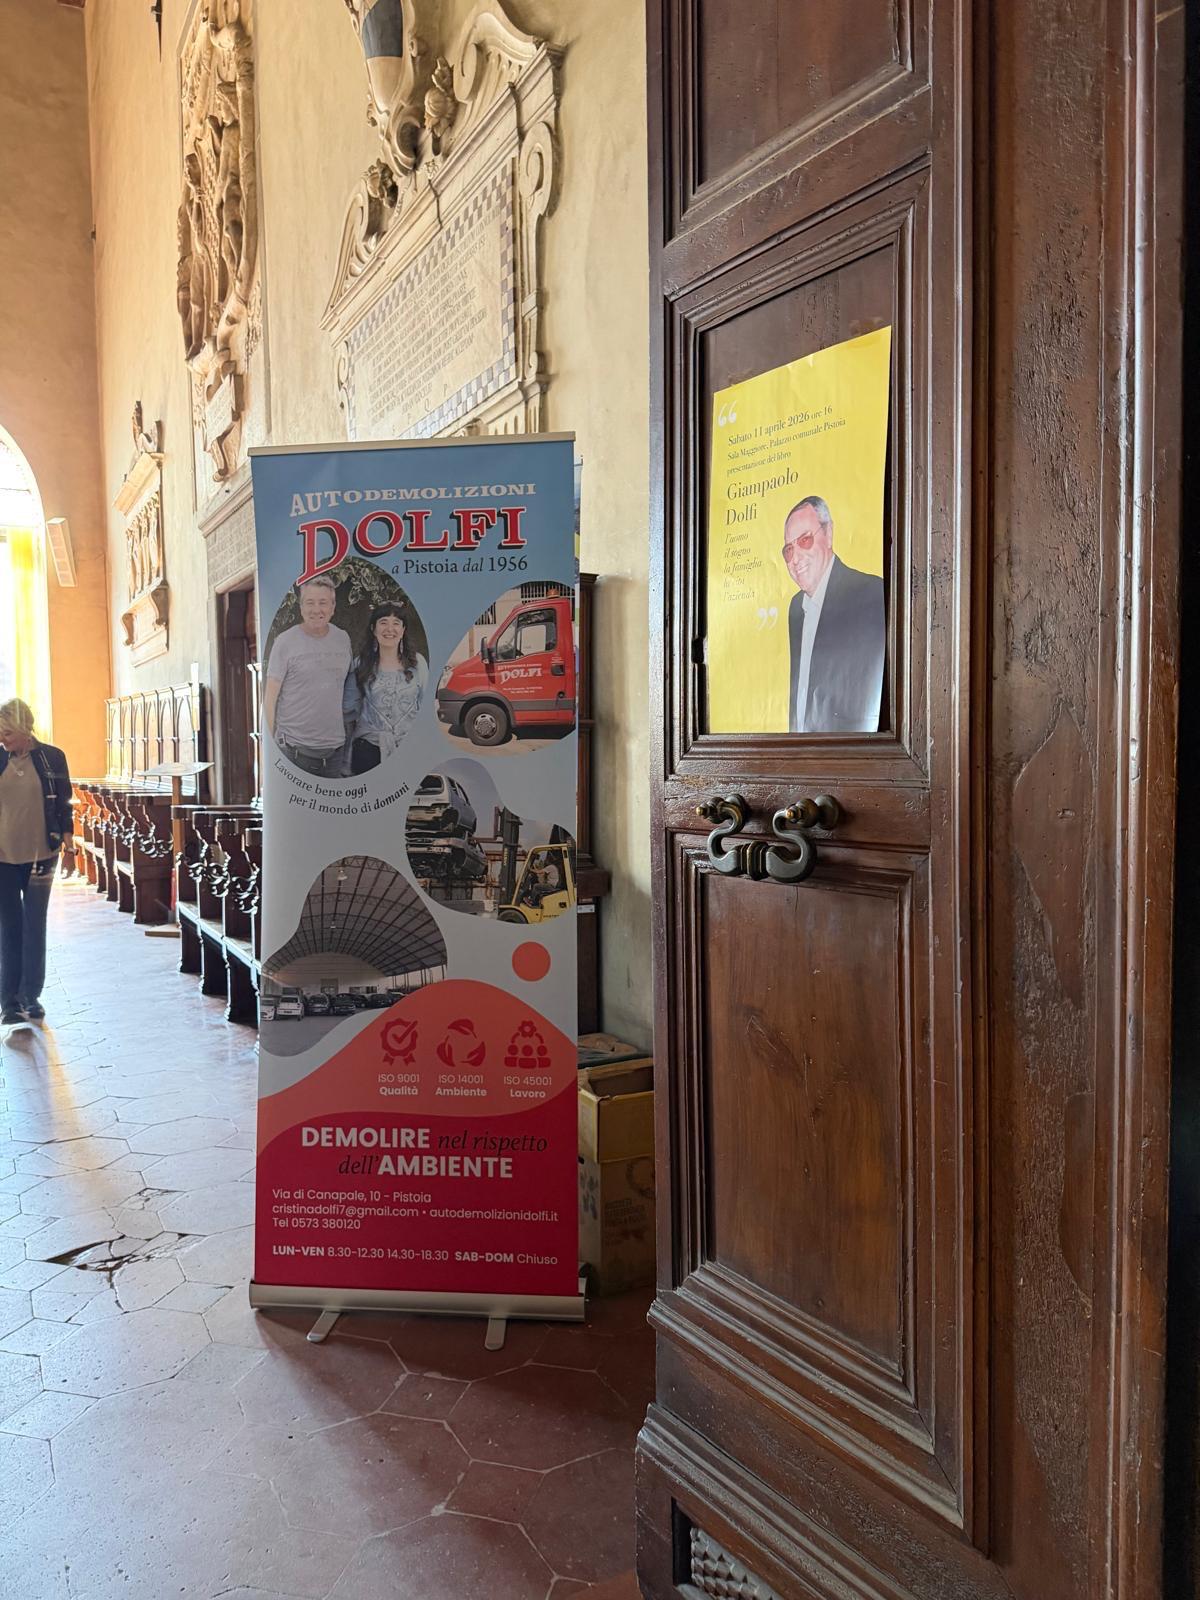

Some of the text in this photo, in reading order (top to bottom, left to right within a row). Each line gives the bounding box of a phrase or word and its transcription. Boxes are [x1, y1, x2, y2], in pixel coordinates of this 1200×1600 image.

[728, 405, 833, 446] Sabato 11 aprile 2026 ore 16
[728, 418, 846, 461] Sala Maggiore, Palazzo comunale Pistoia
[726, 450, 792, 478] presentazione del libro
[727, 467, 799, 501] Giampaolo
[289, 483, 537, 517] AUTODEMOLIZIONI
[726, 503, 757, 526] Dolfi
[296, 506, 527, 586] DOLFI
[731, 548, 751, 559] sogno
[391, 554, 528, 575] a Pistoia dal 1956
[724, 557, 763, 576] la famiglia
[500, 668, 542, 685] DOLFI
[274, 758, 368, 799] Lavorare bene oggi
[288, 782, 410, 815] per il mondo di domani
[378, 1073, 420, 1083] ISO 9001
[438, 1074, 484, 1084] ISO 14001
[504, 1076, 552, 1086] ISO 45001
[379, 1086, 419, 1096] Qualità
[435, 1087, 488, 1097] Ambiente
[510, 1089, 546, 1098] Lavoro
[301, 1126, 548, 1157] DEMOLIRE nel rispetto
[272, 1189, 291, 1199] Via
[294, 1188, 305, 1200] di
[307, 1189, 367, 1203] Canapale,
[370, 1191, 381, 1201] 10
[392, 1191, 432, 1203] Pistoia
[272, 1203, 559, 1222] cristinadolfi7@gmail.com autodemolizionidolfi.it
[272, 1217, 361, 1230] Tel 0573 380120
[272, 1245, 558, 1265] LUN-VEN 8.30-12.30 14.30-18.30 SAB-DOM Chiuso
